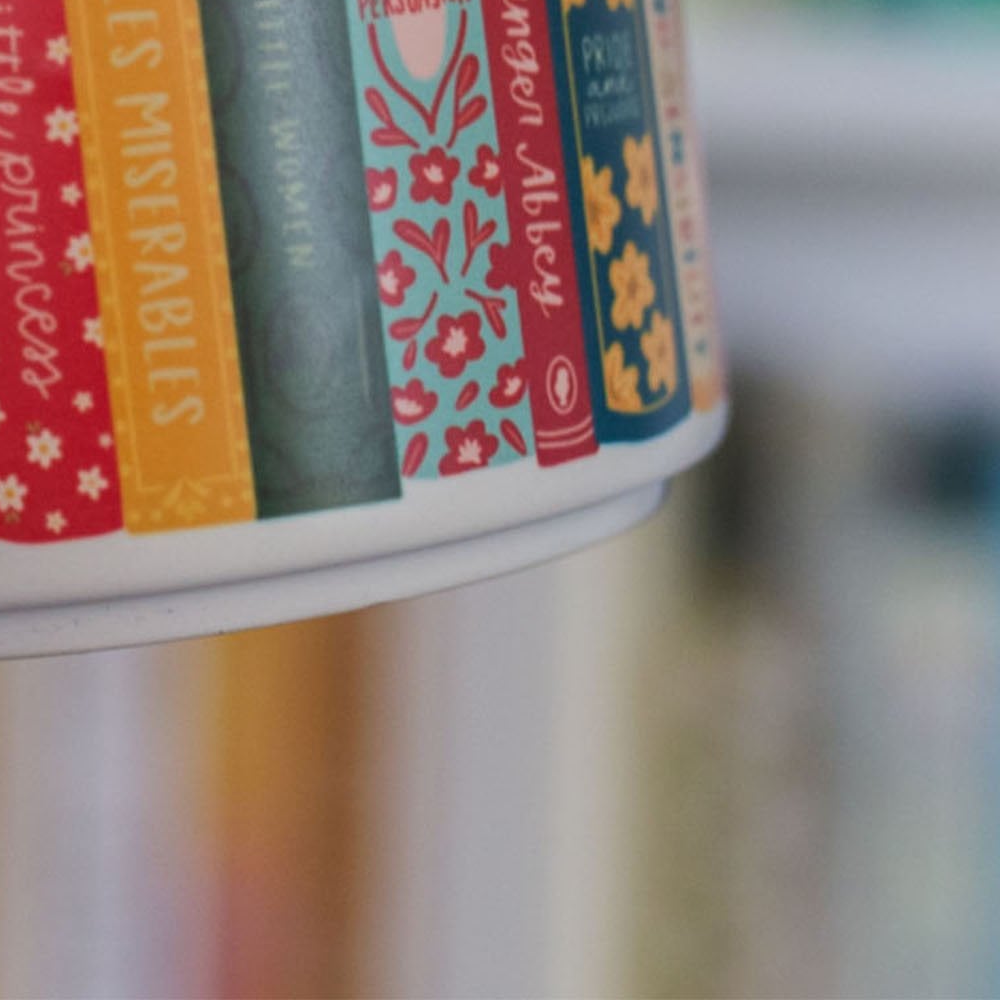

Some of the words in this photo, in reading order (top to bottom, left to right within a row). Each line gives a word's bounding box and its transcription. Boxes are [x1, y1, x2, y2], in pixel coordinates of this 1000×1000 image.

[115, 91, 205, 426] MISERABLES
[269, 119, 315, 268] WOMEN
[515, 142, 564, 319] Abbey
